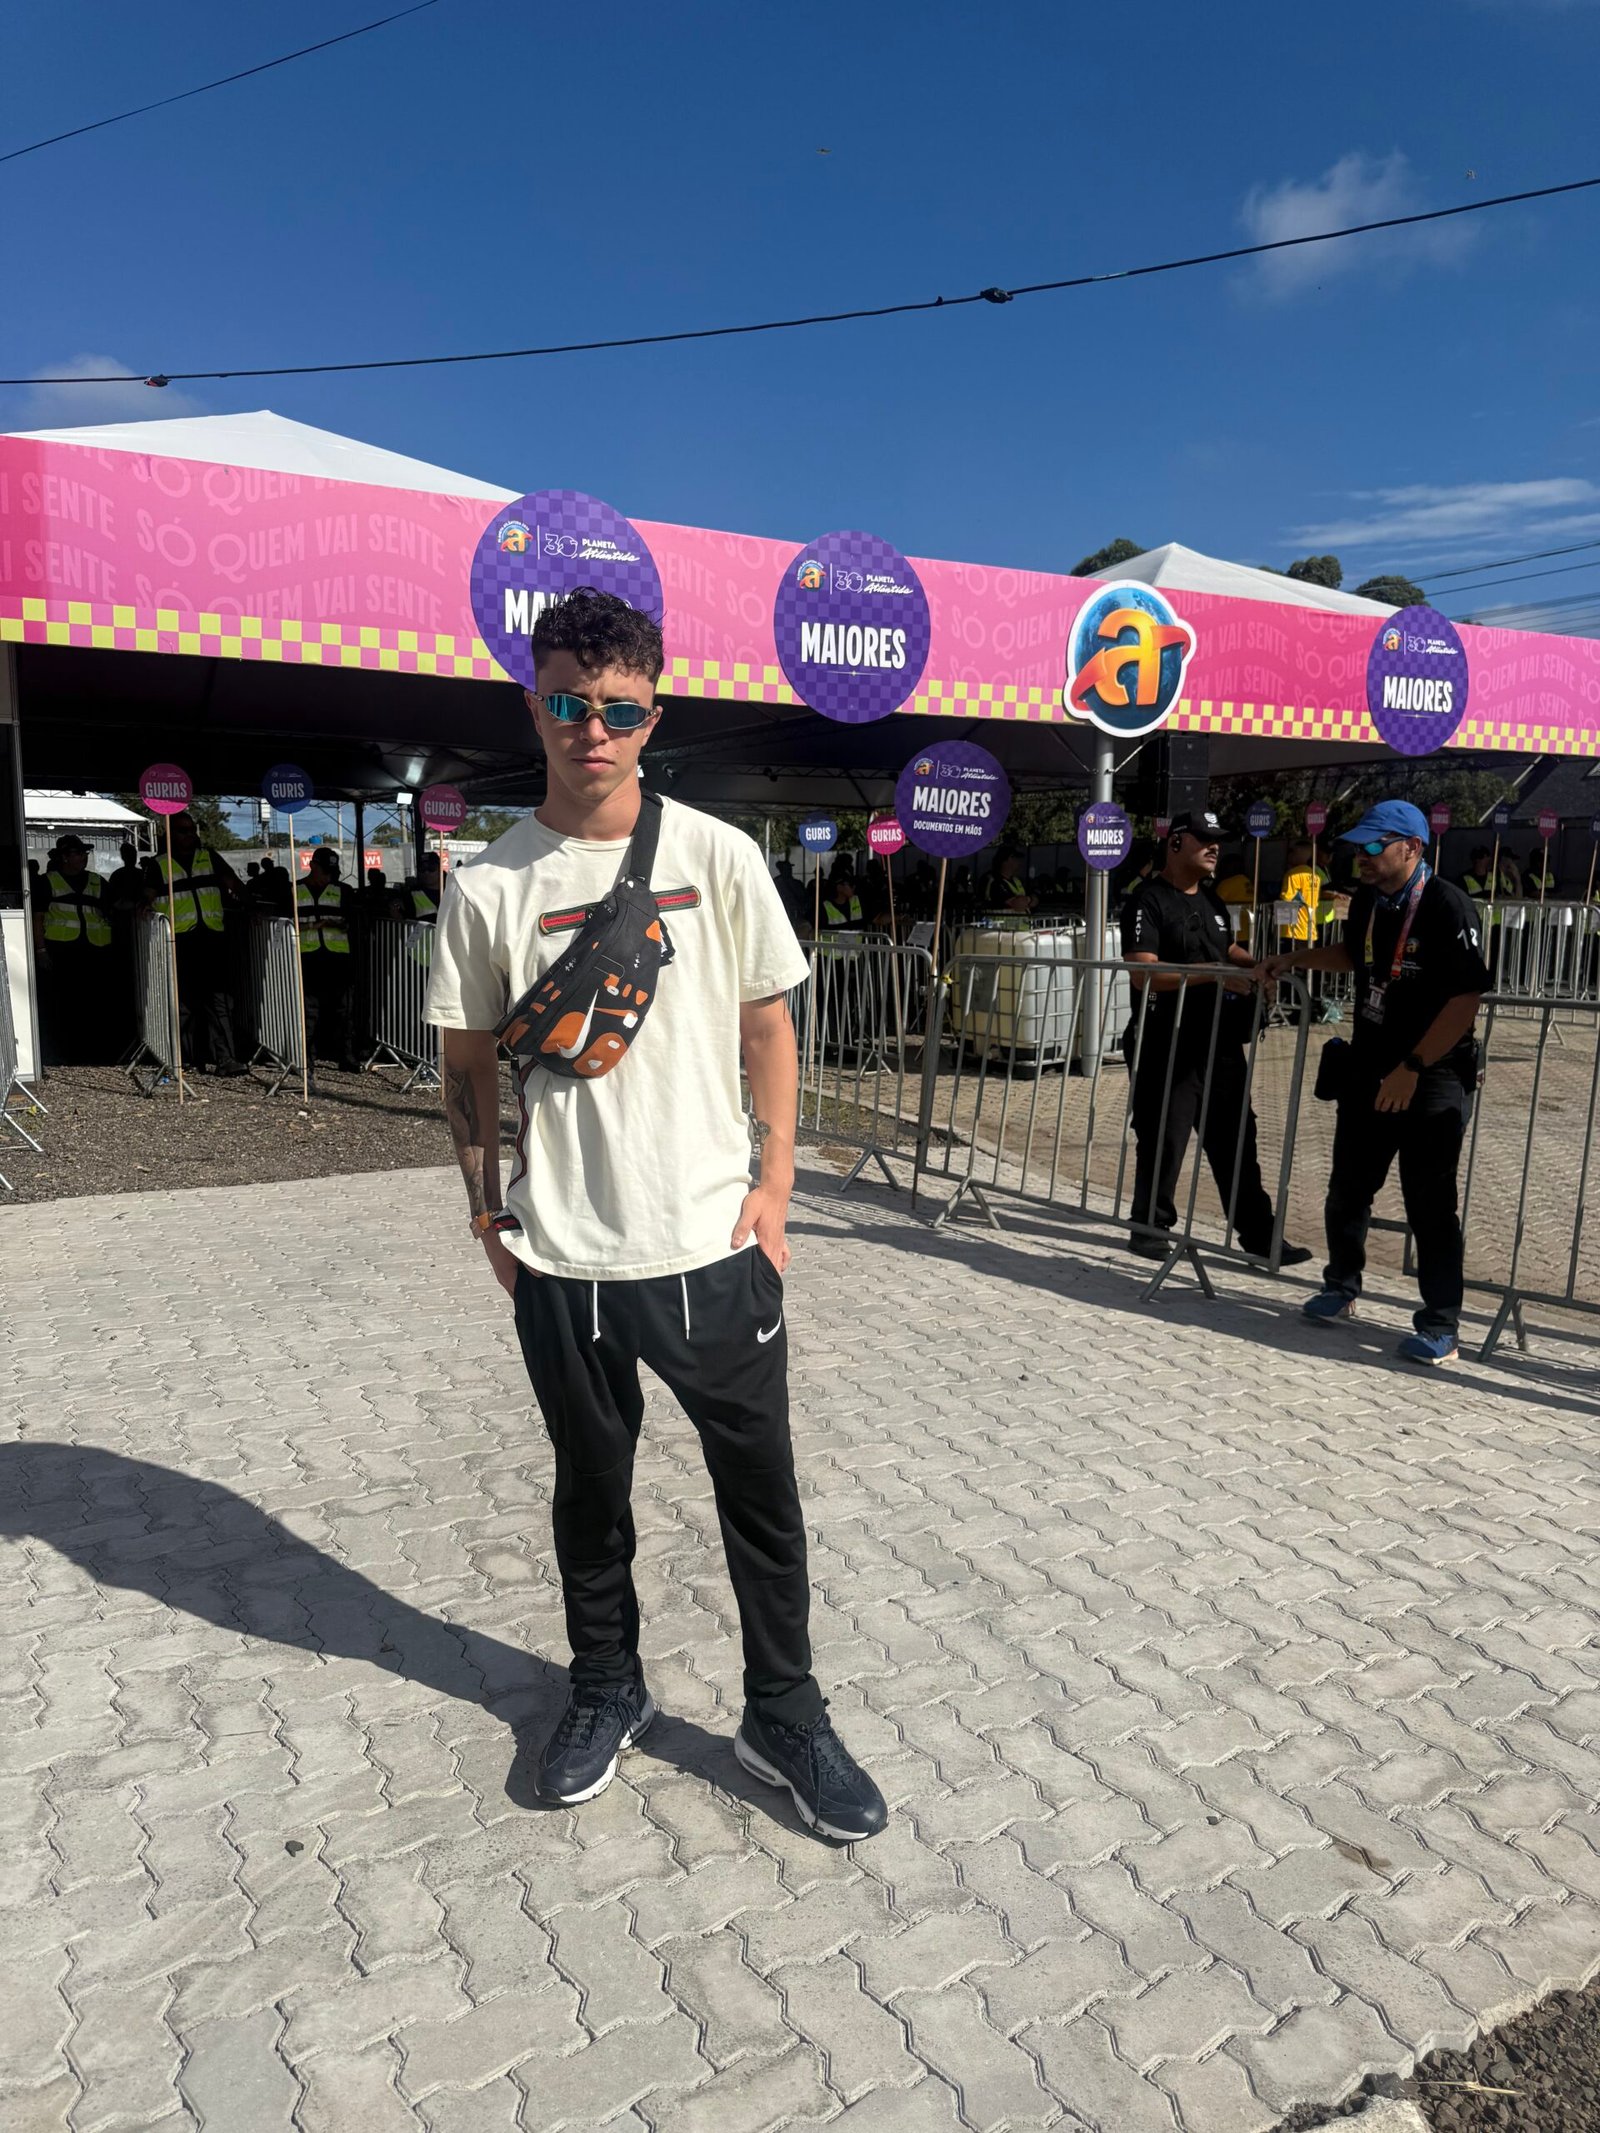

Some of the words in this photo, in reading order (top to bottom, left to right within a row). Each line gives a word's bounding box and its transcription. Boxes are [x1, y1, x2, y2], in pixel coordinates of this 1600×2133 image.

[22, 472, 116, 542] SENTE
[137, 508, 197, 567] SÓ
[208, 522, 305, 583] QUEM
[315, 514, 358, 557] VAI
[368, 513, 446, 577] SENTE
[582, 538, 617, 549] PLANETA
[25, 540, 118, 604] SENTE
[313, 575, 356, 618] VAI
[366, 574, 443, 632] SENTE
[866, 574, 895, 584] PLANETA
[726, 579, 767, 628] SÓ
[951, 604, 986, 649] SÓ
[992, 611, 1051, 660] QUEM
[801, 621, 907, 670] MAIORES
[1219, 621, 1242, 655] VAI
[1247, 620, 1288, 664] SENTE
[1296, 641, 1323, 679] SÓ
[1327, 650, 1367, 688] QUE
[1215, 665, 1238, 698] VAI
[1475, 661, 1517, 700] QUEM
[1521, 653, 1540, 682] VAI
[1543, 653, 1576, 691] SENTE
[1383, 675, 1453, 713] MAIORES
[1517, 692, 1536, 720] VAI
[145, 782, 187, 798] GURIAS
[271, 782, 304, 798] GURIS
[912, 785, 991, 818] MAIORES
[424, 800, 461, 818] GURIAS
[1250, 814, 1270, 826] GURIS
[805, 827, 831, 842] GURIS
[871, 828, 902, 843] GURIAS
[913, 820, 953, 833] DOCUMENTOS
[954, 827, 964, 835] EM
[964, 826, 982, 836] MÃOS
[1086, 829, 1124, 845] MAIORES
[364, 857, 381, 866] W1
